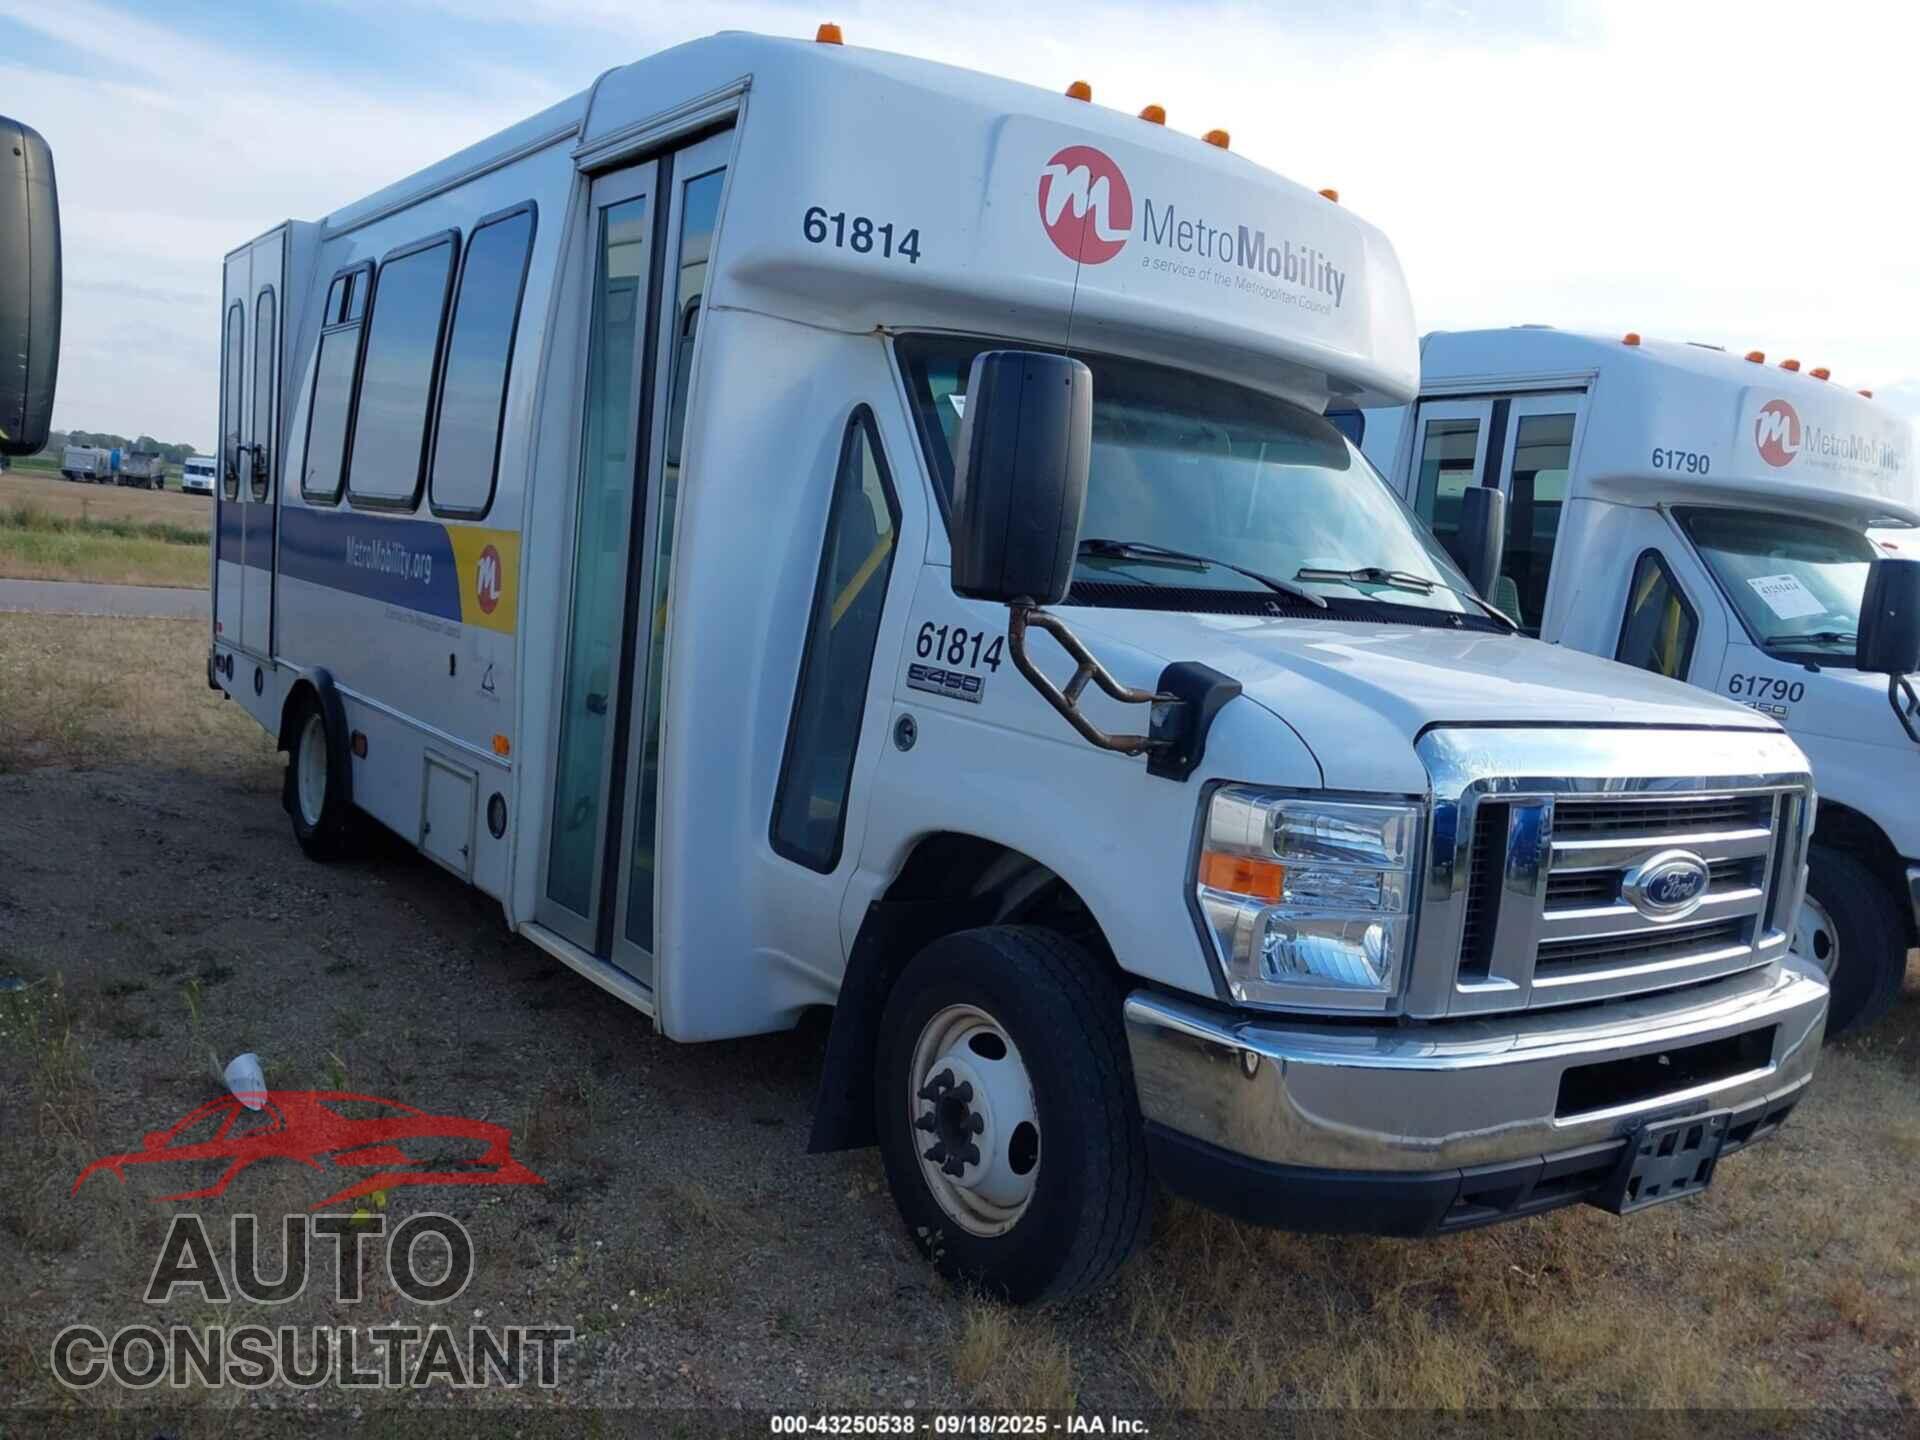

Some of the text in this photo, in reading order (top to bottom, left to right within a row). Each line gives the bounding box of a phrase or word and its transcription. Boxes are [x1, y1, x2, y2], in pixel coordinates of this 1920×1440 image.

[802, 206, 921, 264] 61814
[1143, 198, 1346, 308] MetroMobility
[1142, 256, 1331, 316] a service of the Metropolitan Council
[1652, 447, 1711, 475] 61790
[345, 535, 433, 585] MetroMobility.org
[916, 621, 1005, 673] 61814
[1728, 673, 1805, 703] 61790
[1660, 870, 1697, 900] Ford
